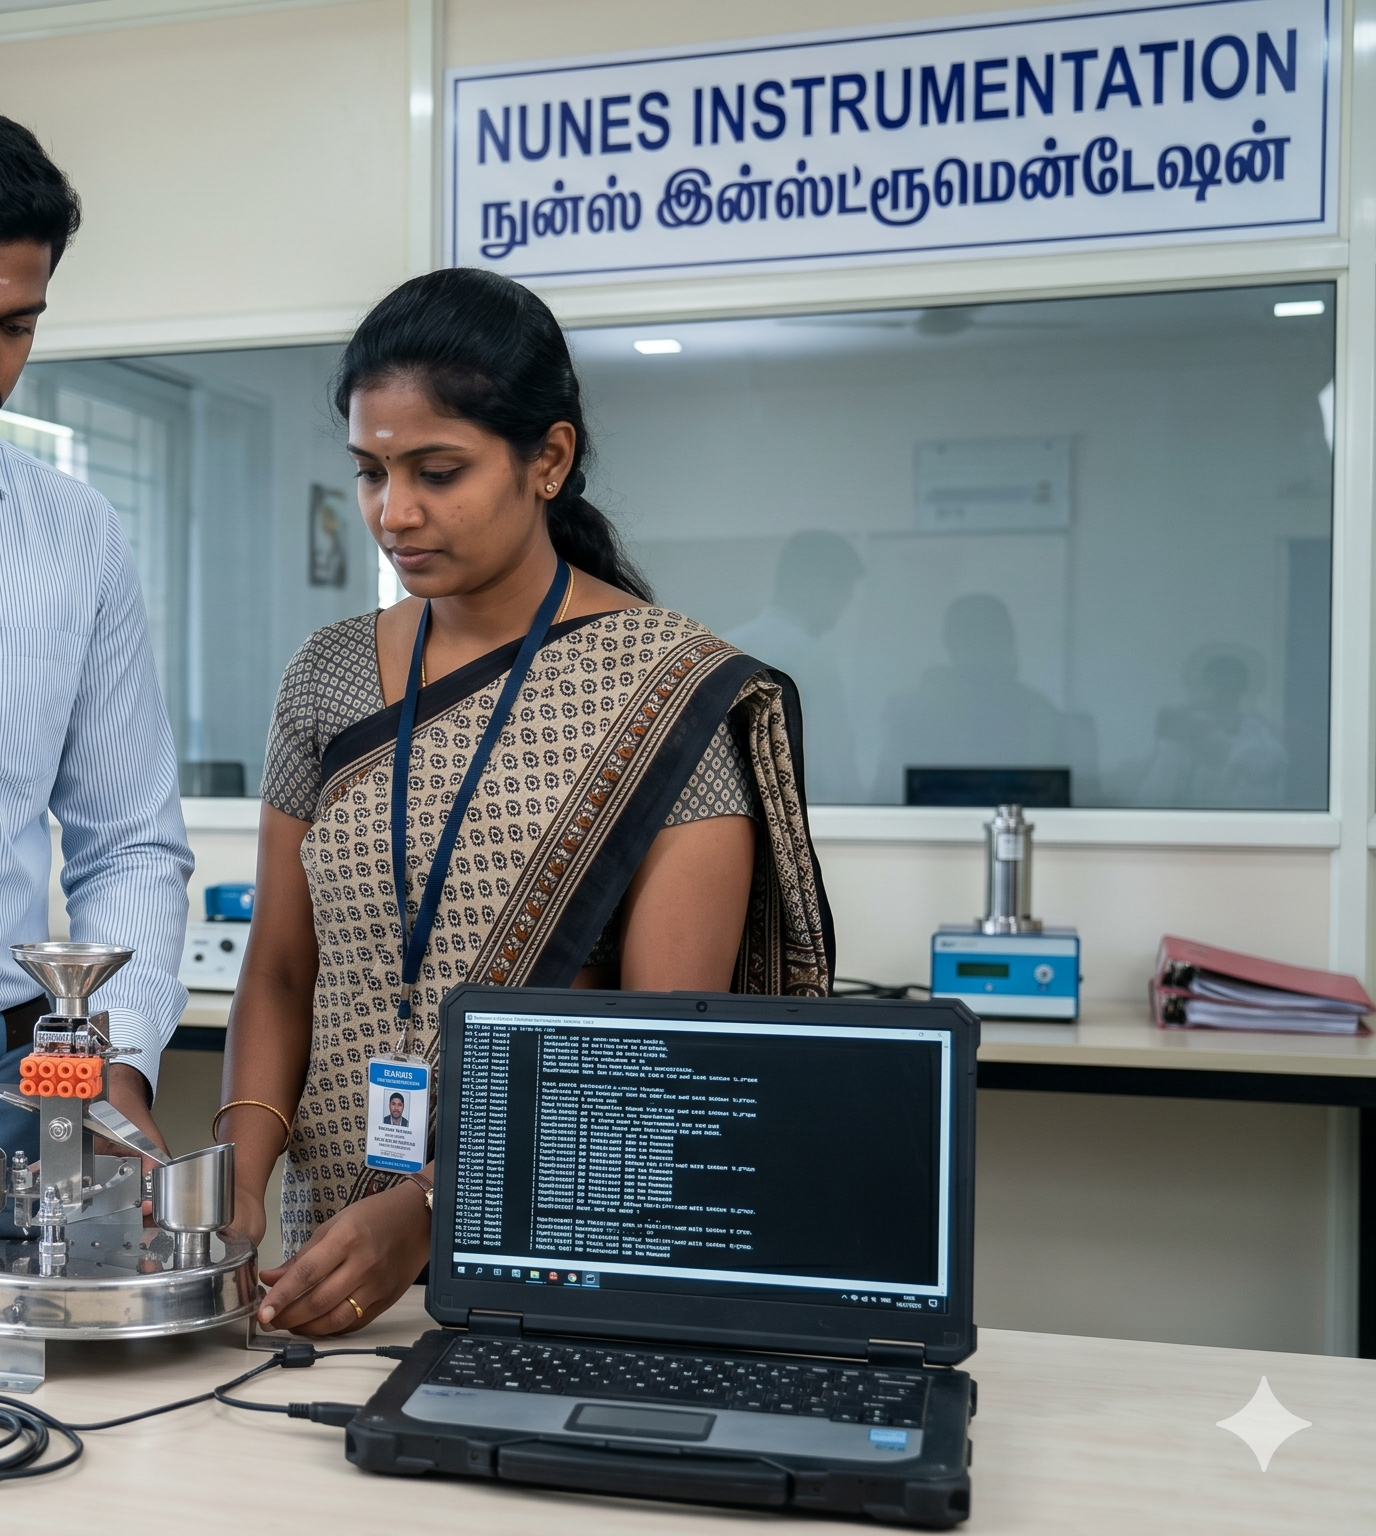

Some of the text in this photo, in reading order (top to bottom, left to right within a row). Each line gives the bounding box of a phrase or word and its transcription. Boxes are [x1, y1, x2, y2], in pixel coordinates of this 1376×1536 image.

[478, 27, 1299, 165] NUNES INSTRUMENTATION
[479, 118, 1293, 260] நுன்ஸ் இன்ஸ்ட்ரூமென்டேஷன்
